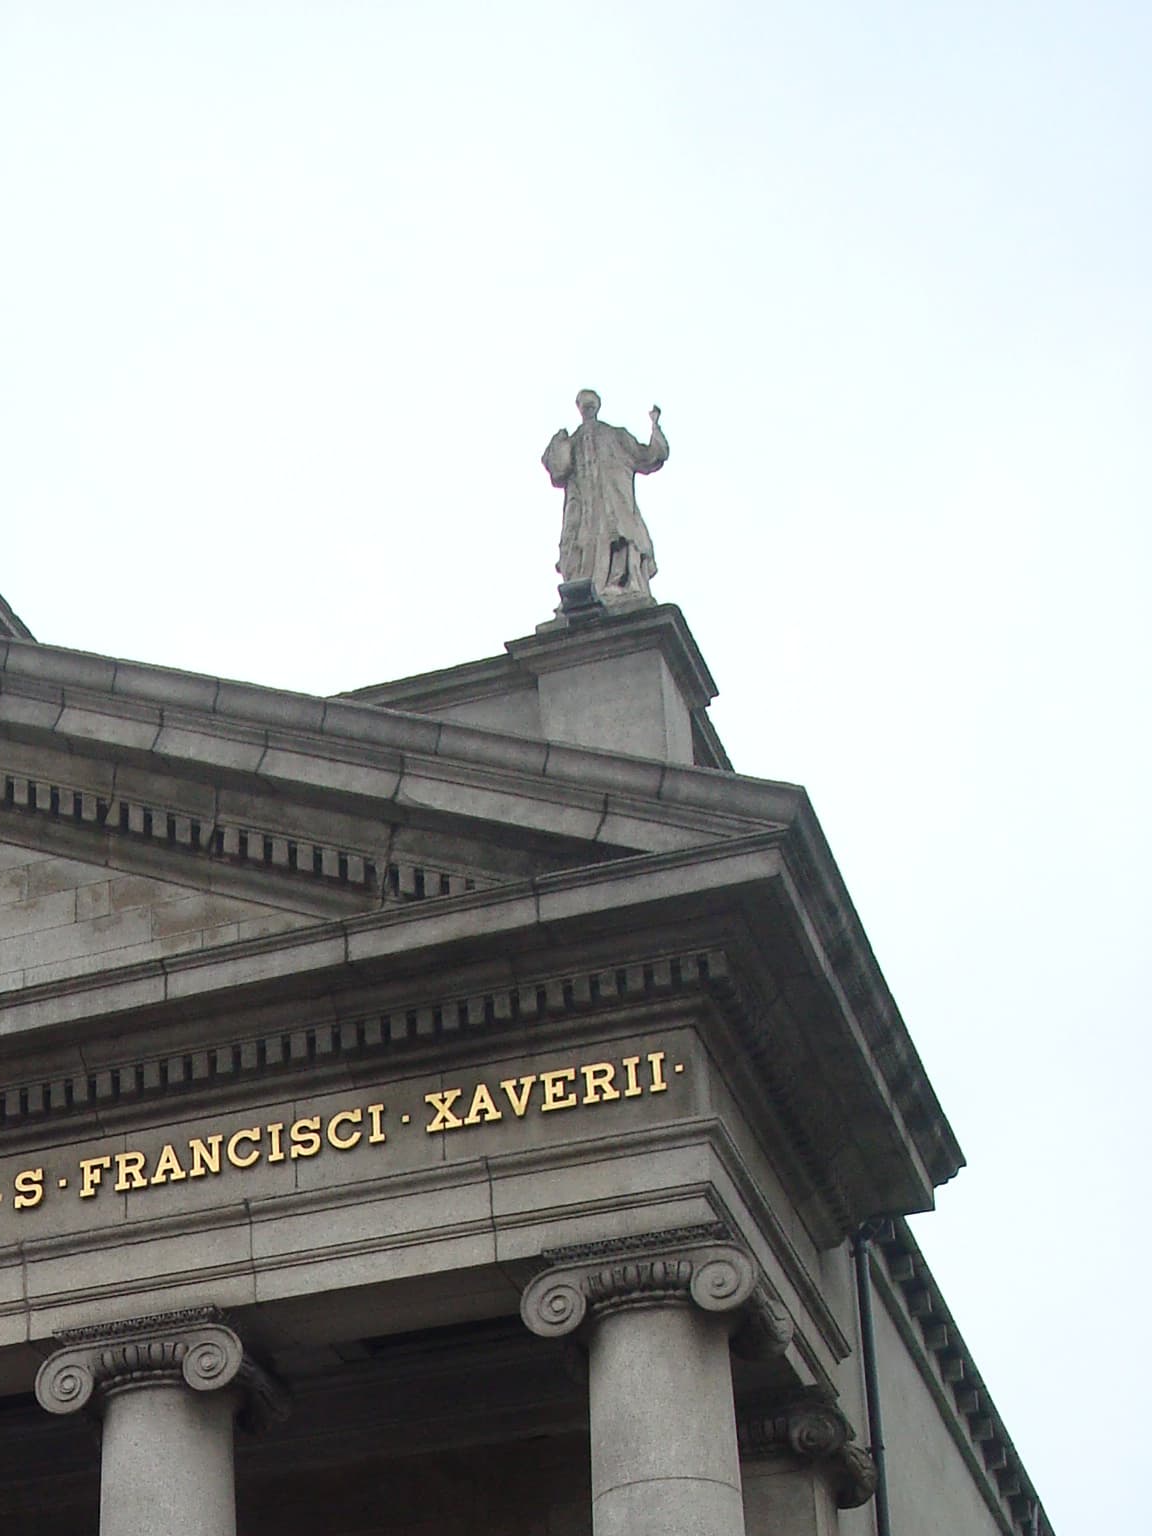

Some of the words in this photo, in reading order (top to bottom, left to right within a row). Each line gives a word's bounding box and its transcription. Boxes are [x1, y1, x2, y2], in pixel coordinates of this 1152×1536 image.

[13, 1167, 44, 1210] S
[79, 1103, 386, 1198] FRANCISCI
[424, 1051, 667, 1133] XAVERII
